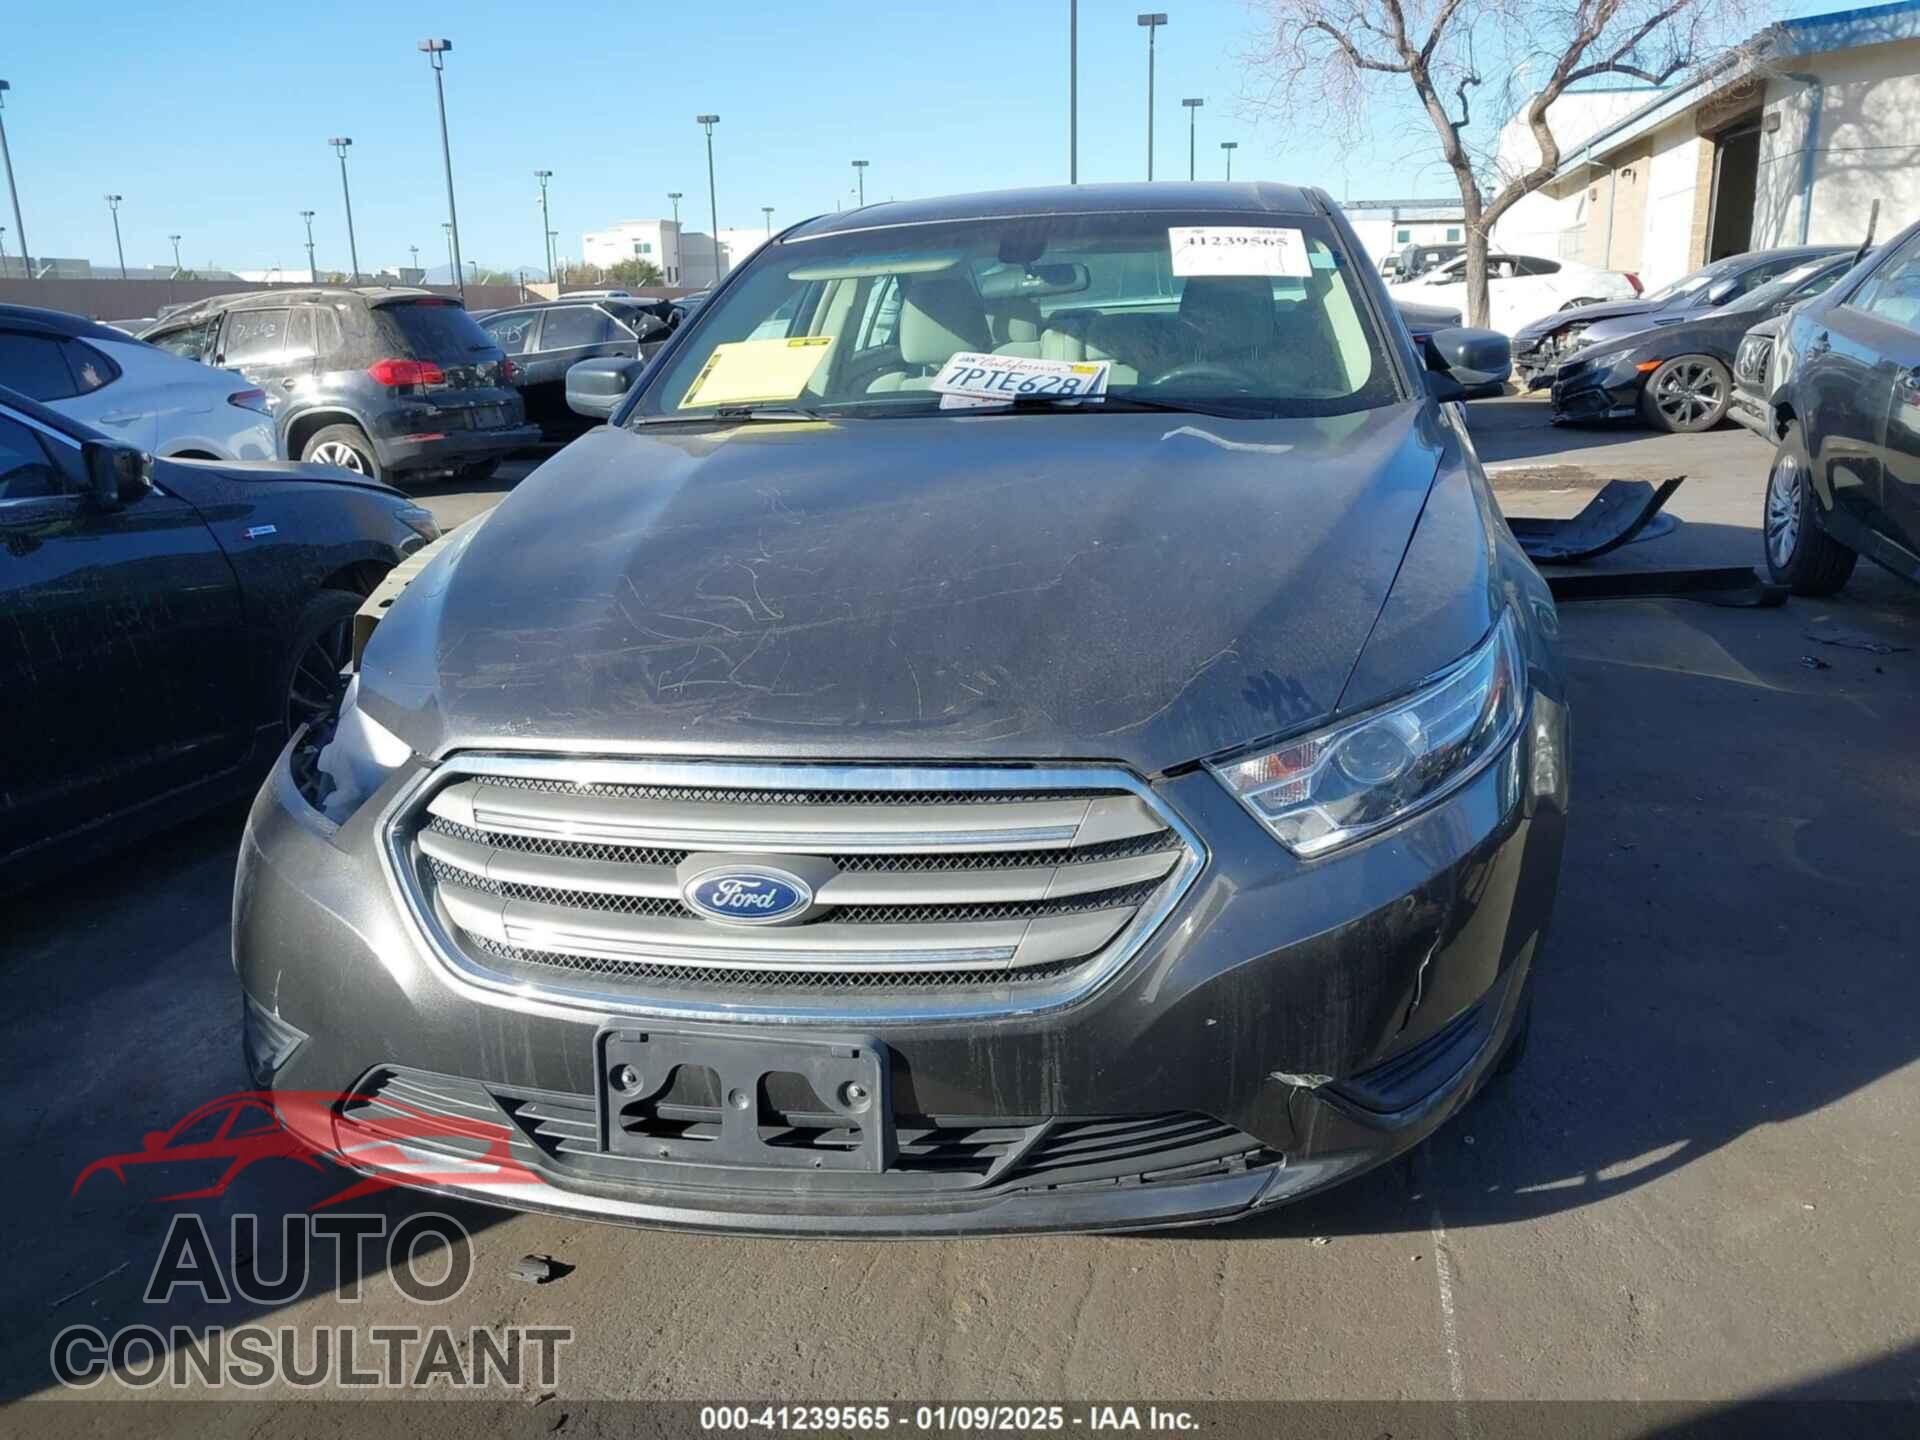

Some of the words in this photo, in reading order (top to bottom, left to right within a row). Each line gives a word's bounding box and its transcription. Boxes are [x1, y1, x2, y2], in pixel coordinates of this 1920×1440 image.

[1185, 236, 1289, 247] 41239565
[977, 355, 1063, 372] California
[946, 366, 1082, 395] 7PTE628
[712, 879, 777, 909] Ford
